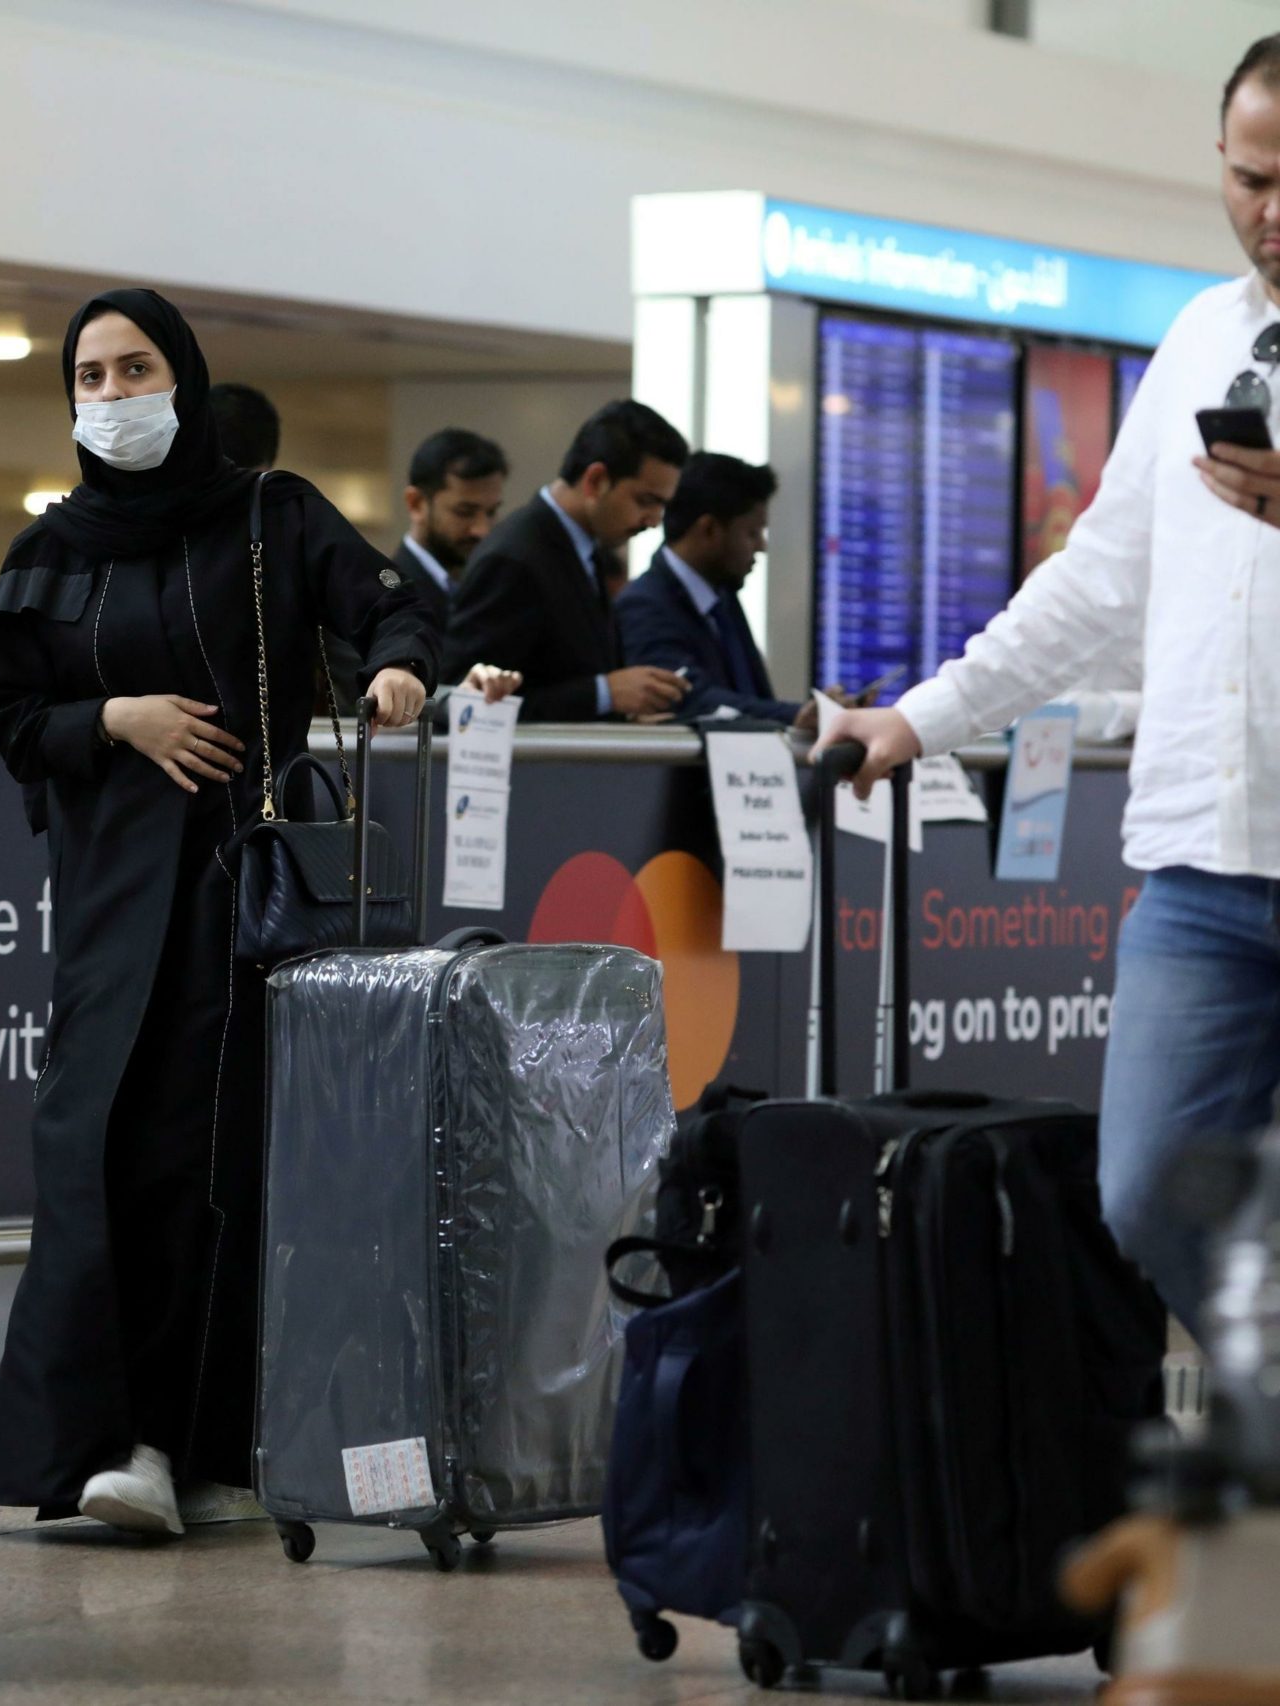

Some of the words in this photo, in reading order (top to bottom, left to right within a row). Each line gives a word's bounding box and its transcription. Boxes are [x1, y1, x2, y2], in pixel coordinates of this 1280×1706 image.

[923, 889, 1109, 961] Something
[953, 998, 996, 1043] on
[1003, 986, 1042, 1041] to
[1049, 976, 1113, 1055] pric
